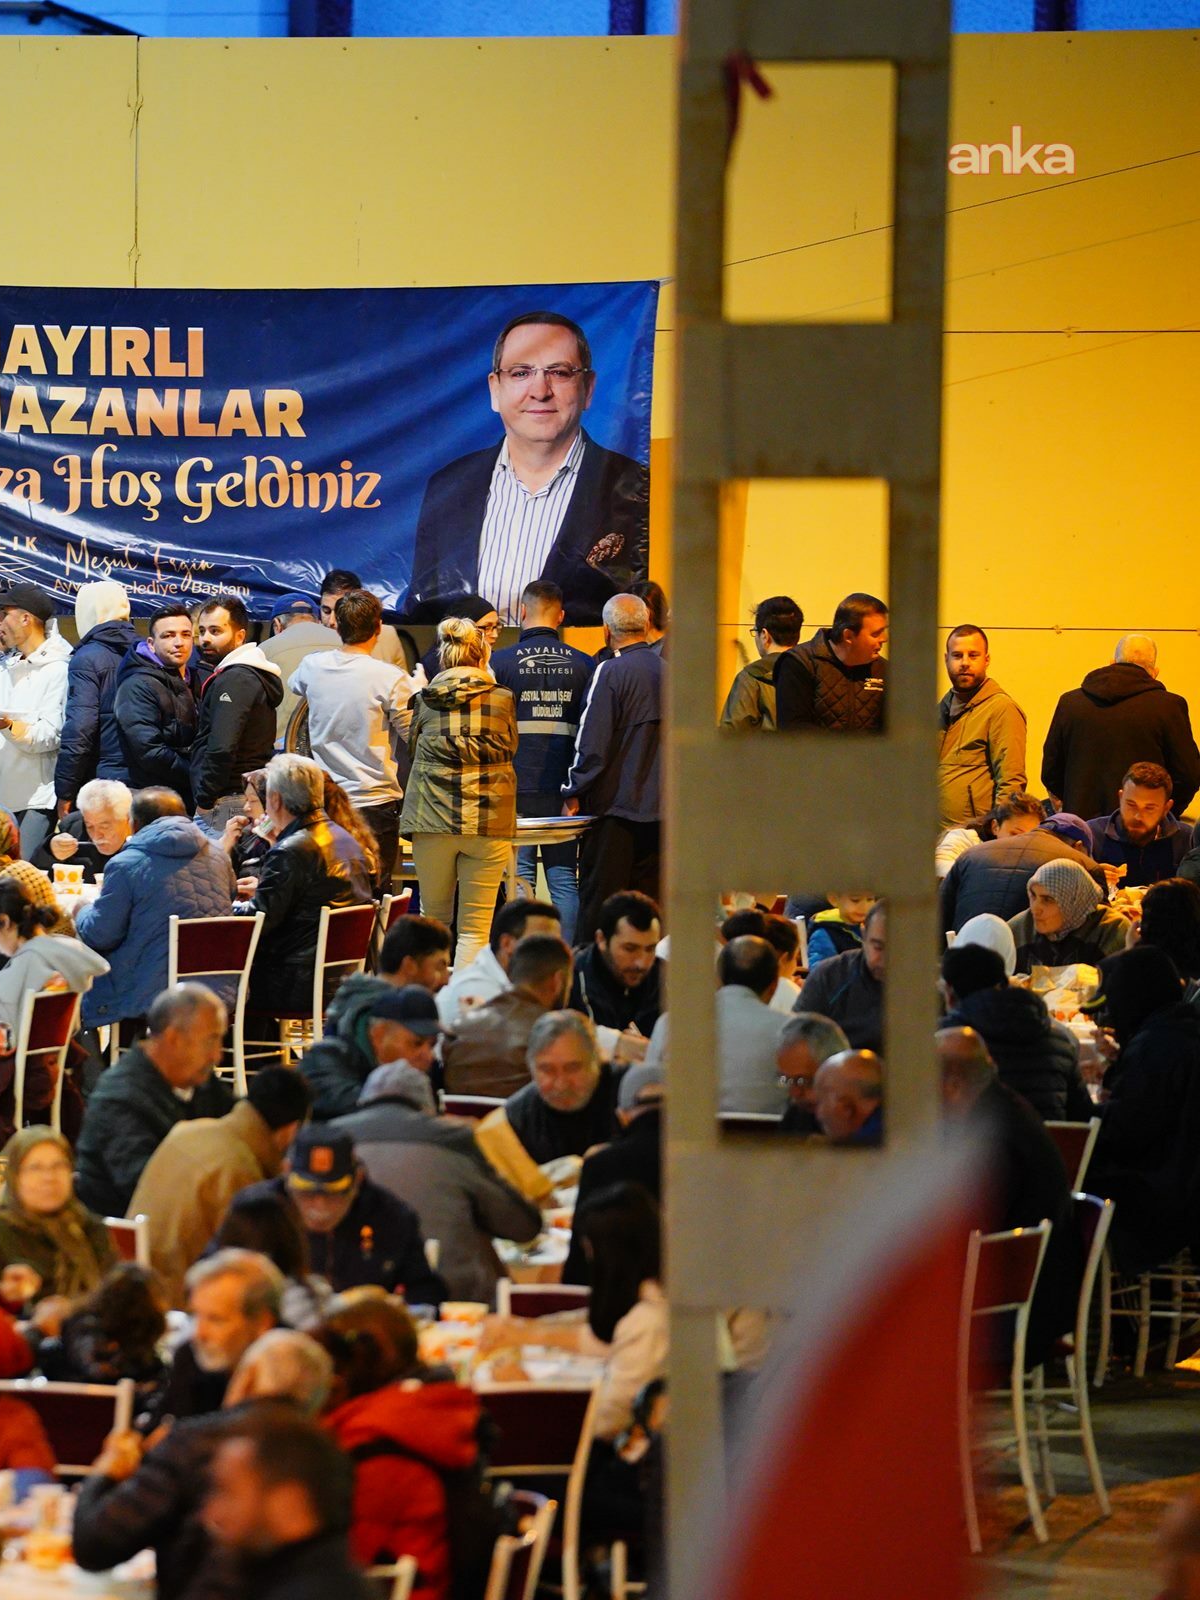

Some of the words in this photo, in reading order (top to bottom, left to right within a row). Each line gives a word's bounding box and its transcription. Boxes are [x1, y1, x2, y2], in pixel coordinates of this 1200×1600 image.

[51, 443, 162, 521] Hoş
[174, 455, 381, 523] Geldiniz
[65, 538, 139, 579] Mesut
[152, 543, 216, 592] Ergin
[122, 581, 178, 597] elediye
[516, 646, 573, 656] AYVALIK
